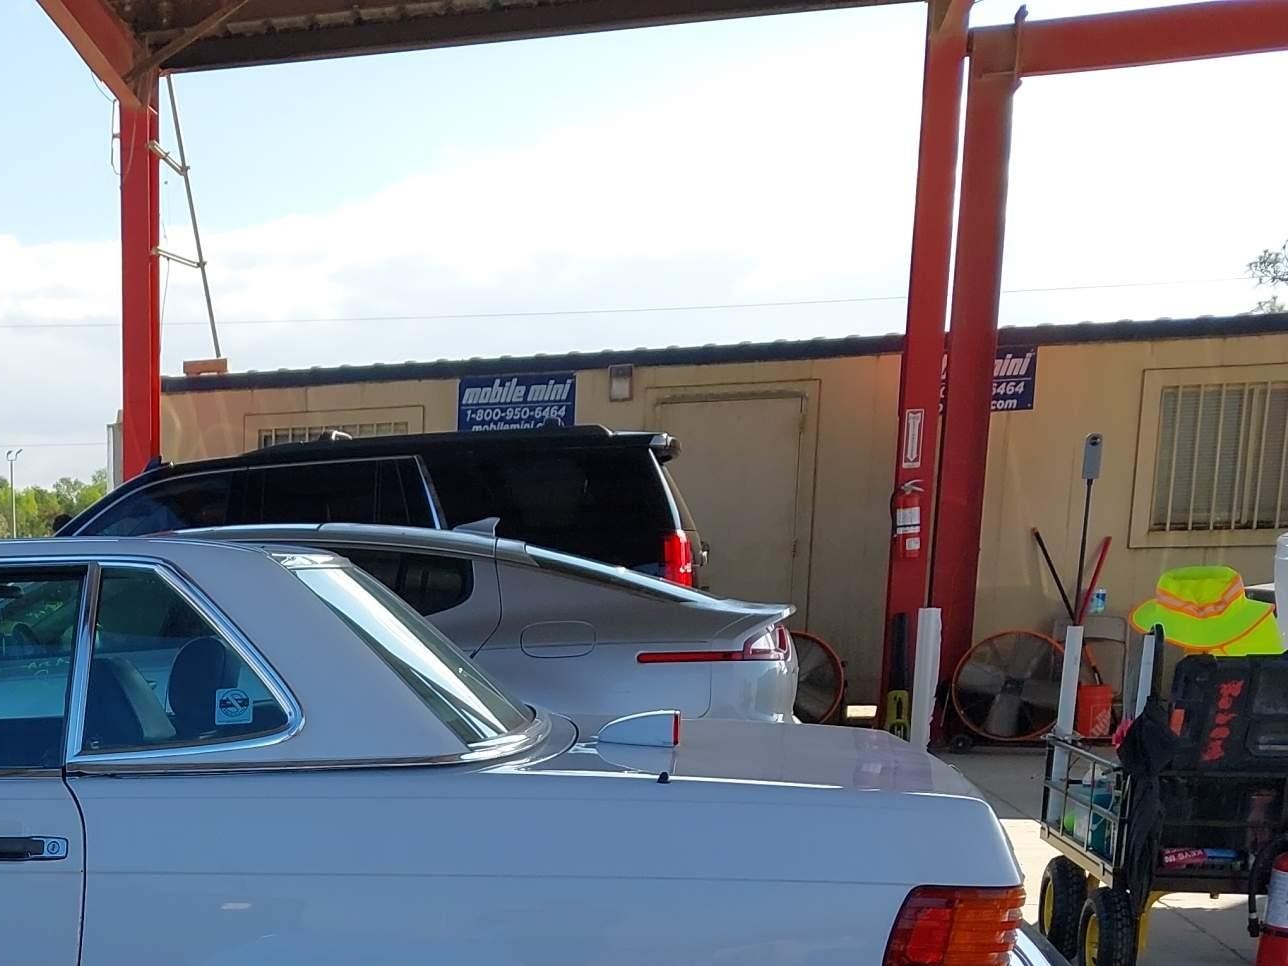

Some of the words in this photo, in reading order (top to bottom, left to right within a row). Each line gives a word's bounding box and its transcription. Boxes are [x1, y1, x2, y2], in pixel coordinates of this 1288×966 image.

[462, 377, 526, 404] mobile
[527, 379, 572, 401] mini
[466, 405, 566, 422] 1-800-950-6464
